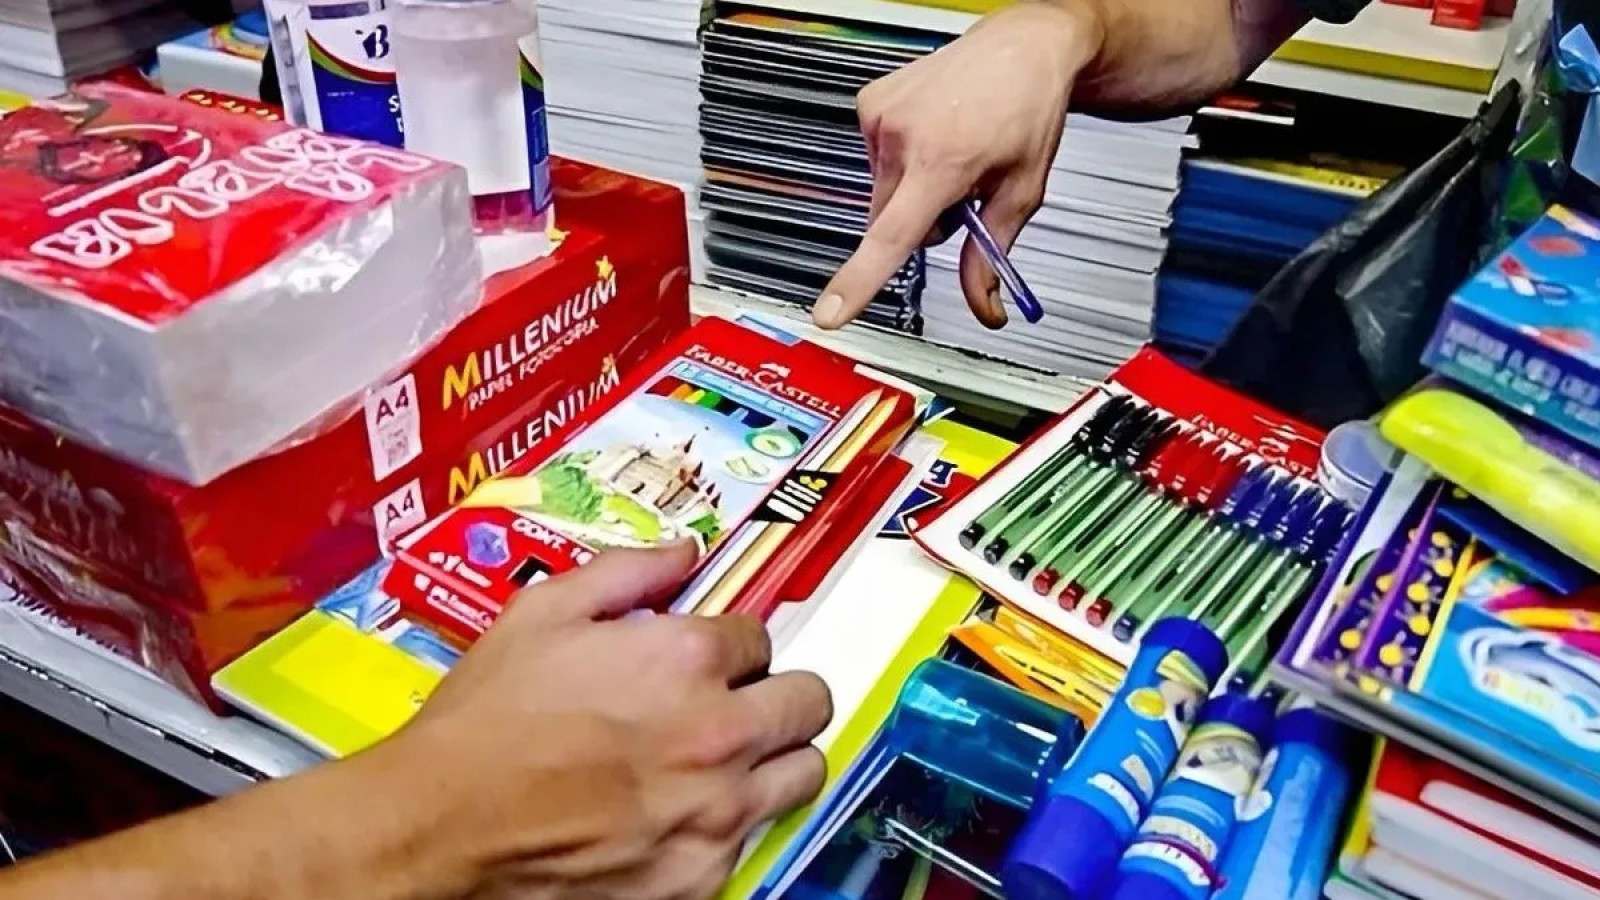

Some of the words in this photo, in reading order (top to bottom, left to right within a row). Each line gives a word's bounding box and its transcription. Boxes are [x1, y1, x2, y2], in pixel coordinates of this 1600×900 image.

[442, 271, 618, 411] MILLENIUM
[375, 384, 410, 425] A4
[386, 488, 415, 529] A4
